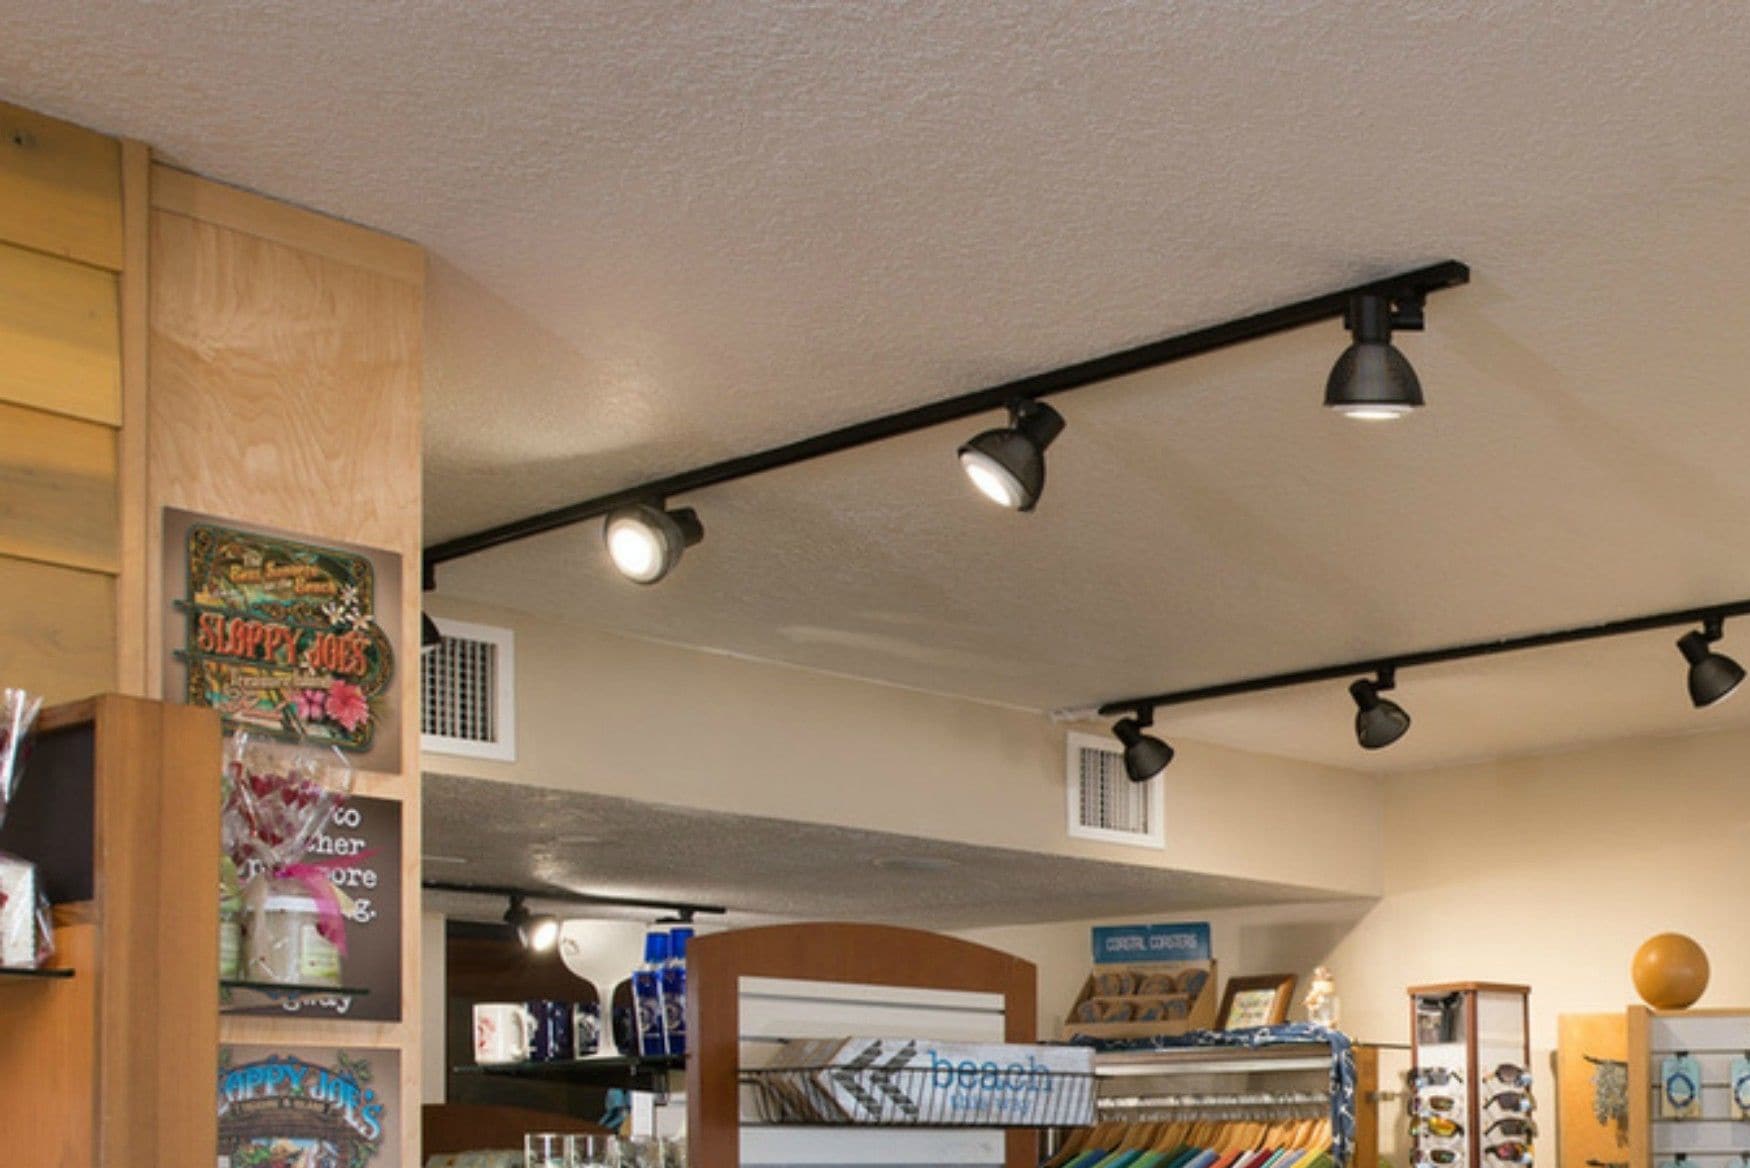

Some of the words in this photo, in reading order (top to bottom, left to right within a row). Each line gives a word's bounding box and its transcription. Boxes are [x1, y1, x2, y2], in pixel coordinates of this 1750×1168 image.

[200, 612, 304, 665] SLOPPY
[308, 832, 368, 856] her
[329, 866, 378, 889] ore
[927, 1048, 1053, 1092] beach
